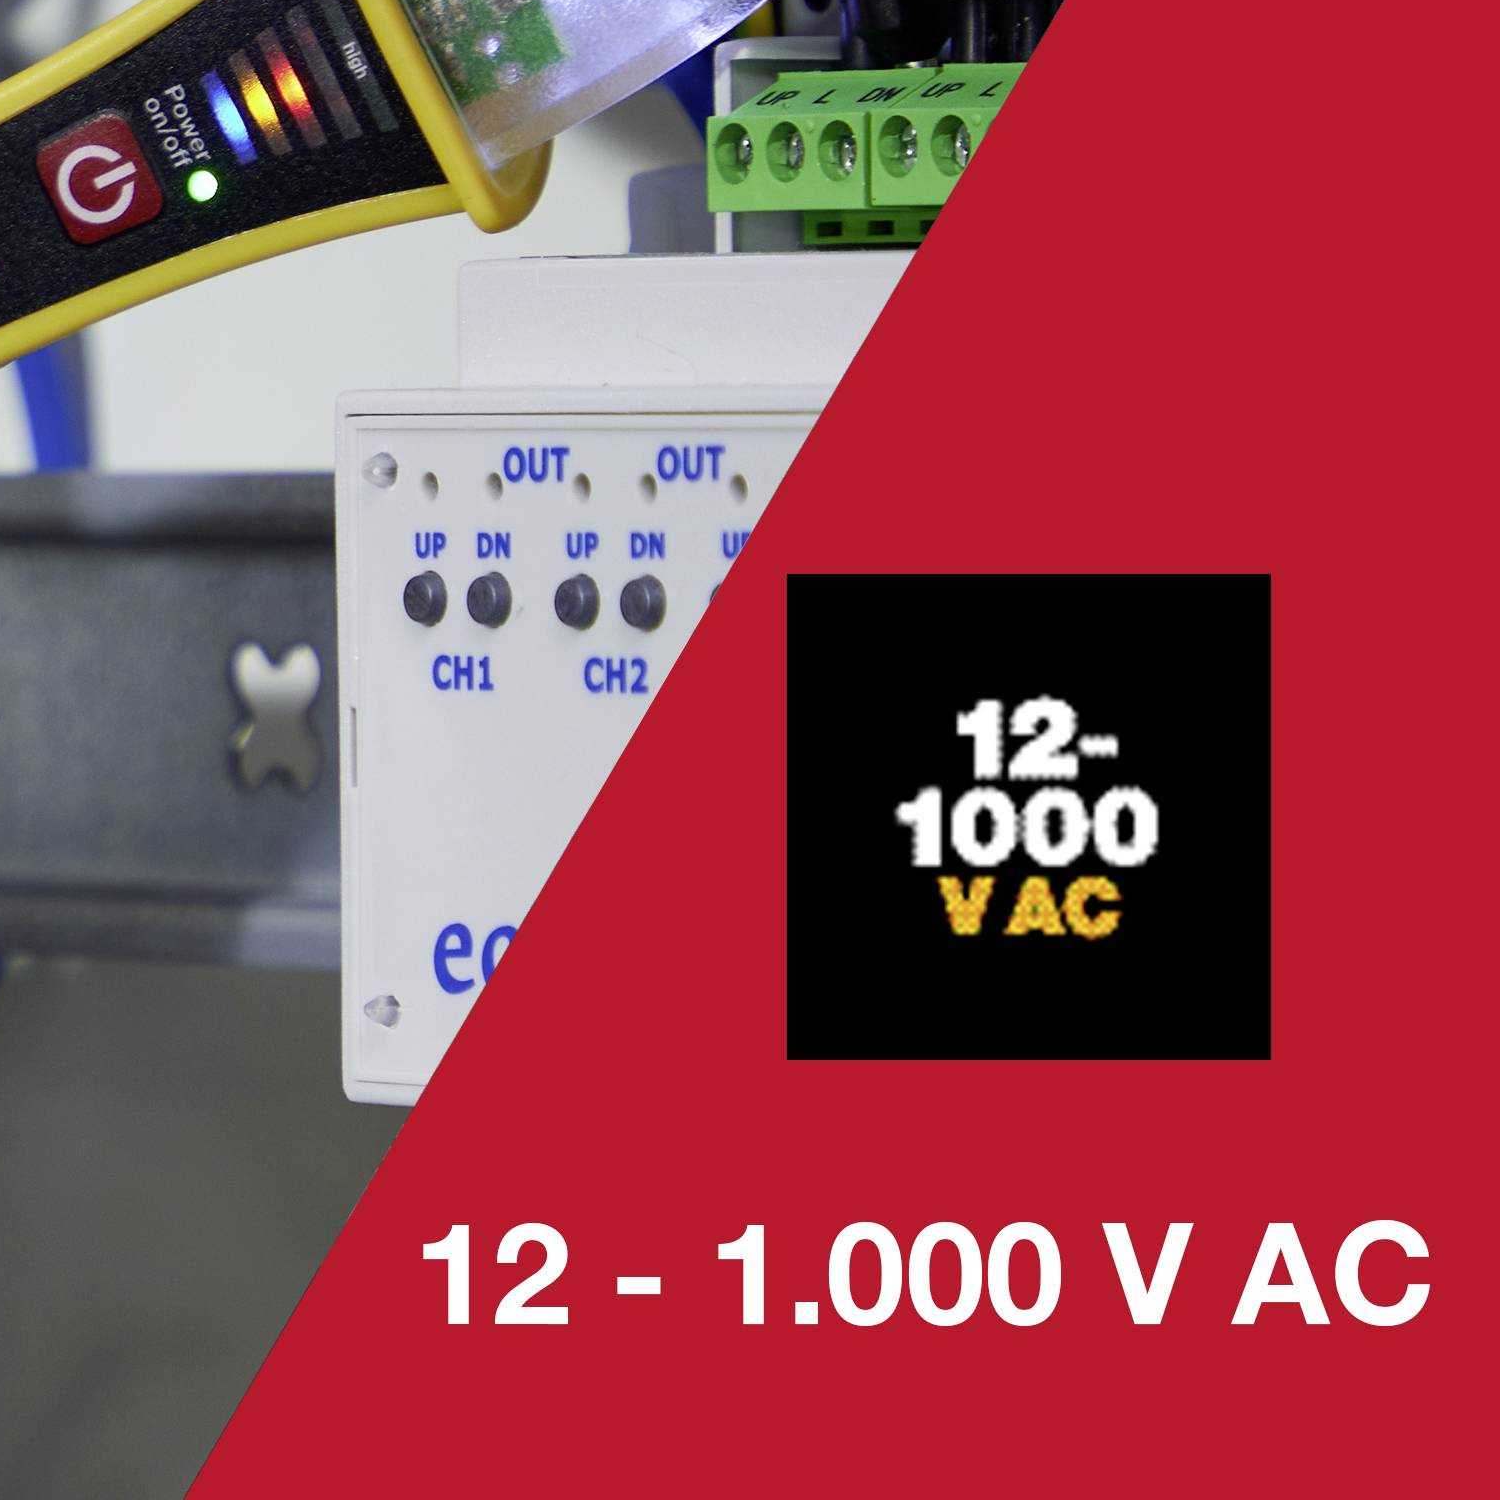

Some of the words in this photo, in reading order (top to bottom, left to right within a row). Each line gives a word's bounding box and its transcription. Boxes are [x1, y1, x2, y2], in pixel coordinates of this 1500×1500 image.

[342, 41, 368, 79] high
[756, 90, 800, 106] UP
[812, 89, 837, 105] L
[856, 86, 906, 104] DN
[921, 82, 966, 99] UP
[979, 81, 1002, 98] L
[144, 97, 193, 167] on/off
[164, 83, 212, 160] Power
[503, 446, 570, 484] OUT
[656, 445, 725, 482] OUT
[415, 531, 447, 560] UP
[476, 531, 511, 560] DN
[566, 531, 599, 560] UP
[630, 531, 666, 560] DN
[432, 654, 494, 691] CH1
[583, 656, 649, 694] CH2
